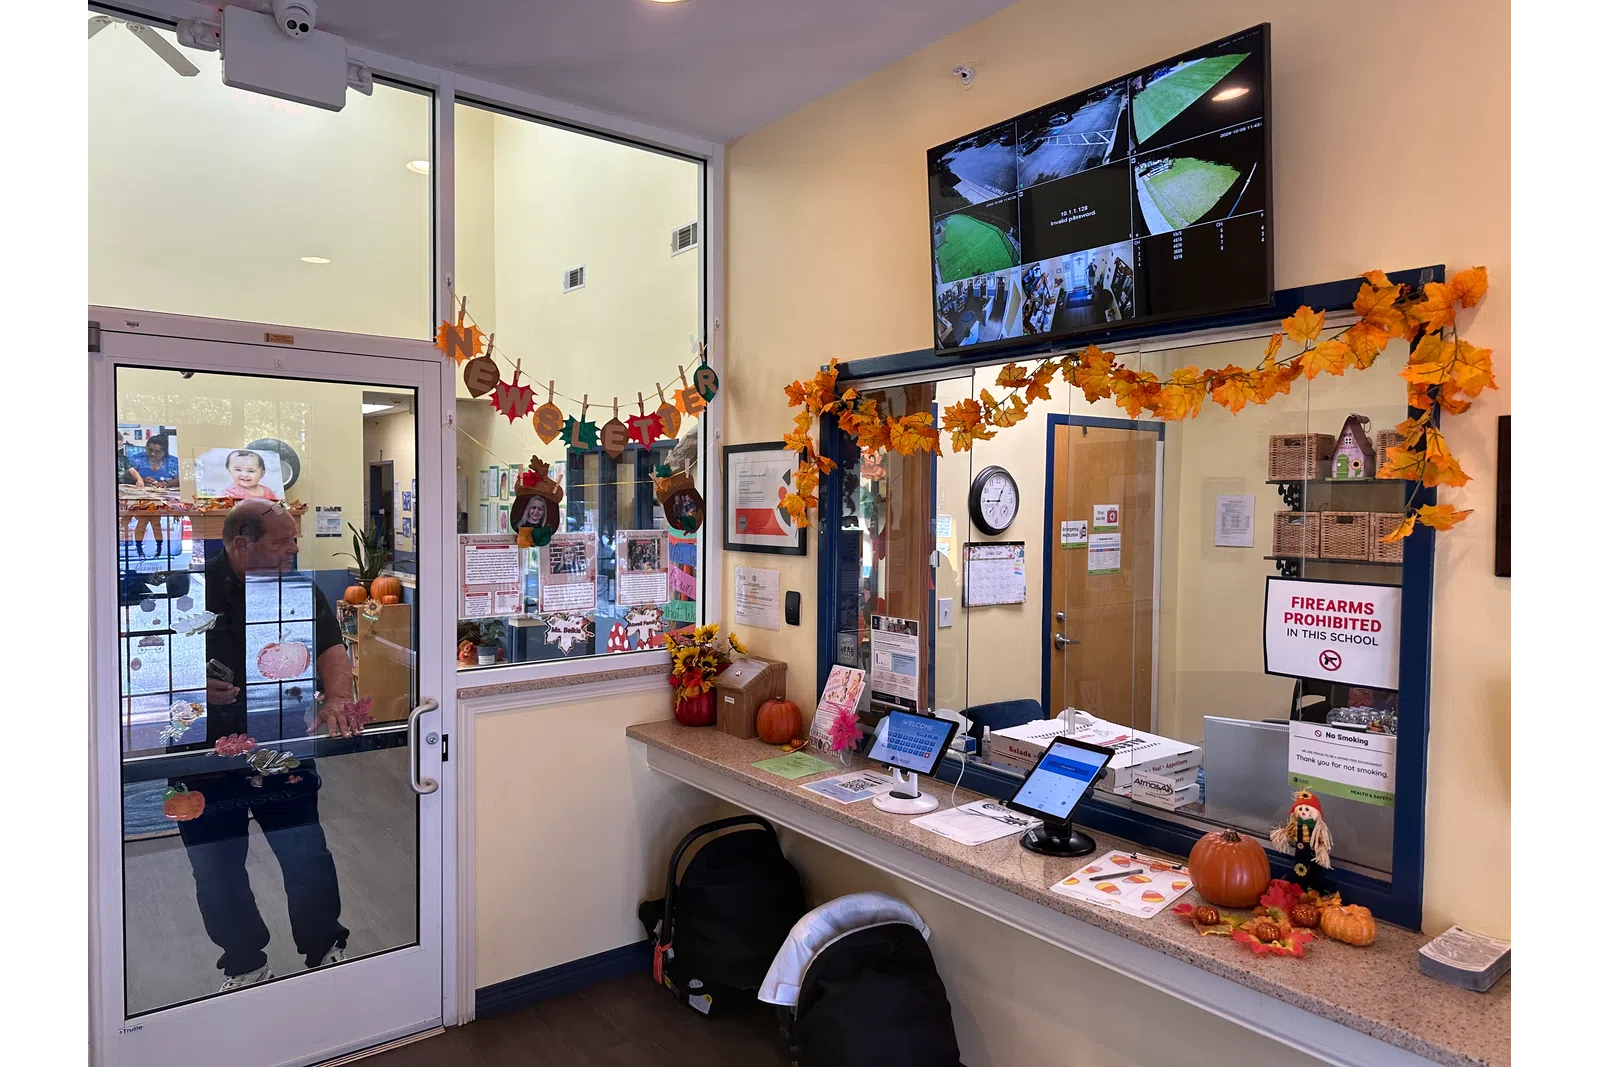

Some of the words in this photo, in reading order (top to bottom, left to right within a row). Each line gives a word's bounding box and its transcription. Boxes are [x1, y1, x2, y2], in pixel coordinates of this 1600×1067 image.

[1050, 217, 1068, 226] Invalid
[1291, 596, 1374, 615] FIREARMS
[1284, 612, 1382, 632] PROHIBITED
[1286, 628, 1298, 637] IN
[1302, 630, 1327, 640] THIS
[1330, 632, 1379, 646] SCHOOL
[902, 719, 935, 731] WELCOME
[1337, 734, 1369, 746] Smoking
[1009, 746, 1031, 758] Salads
[1296, 754, 1316, 763] Thank
[1357, 768, 1389, 778] smoking.
